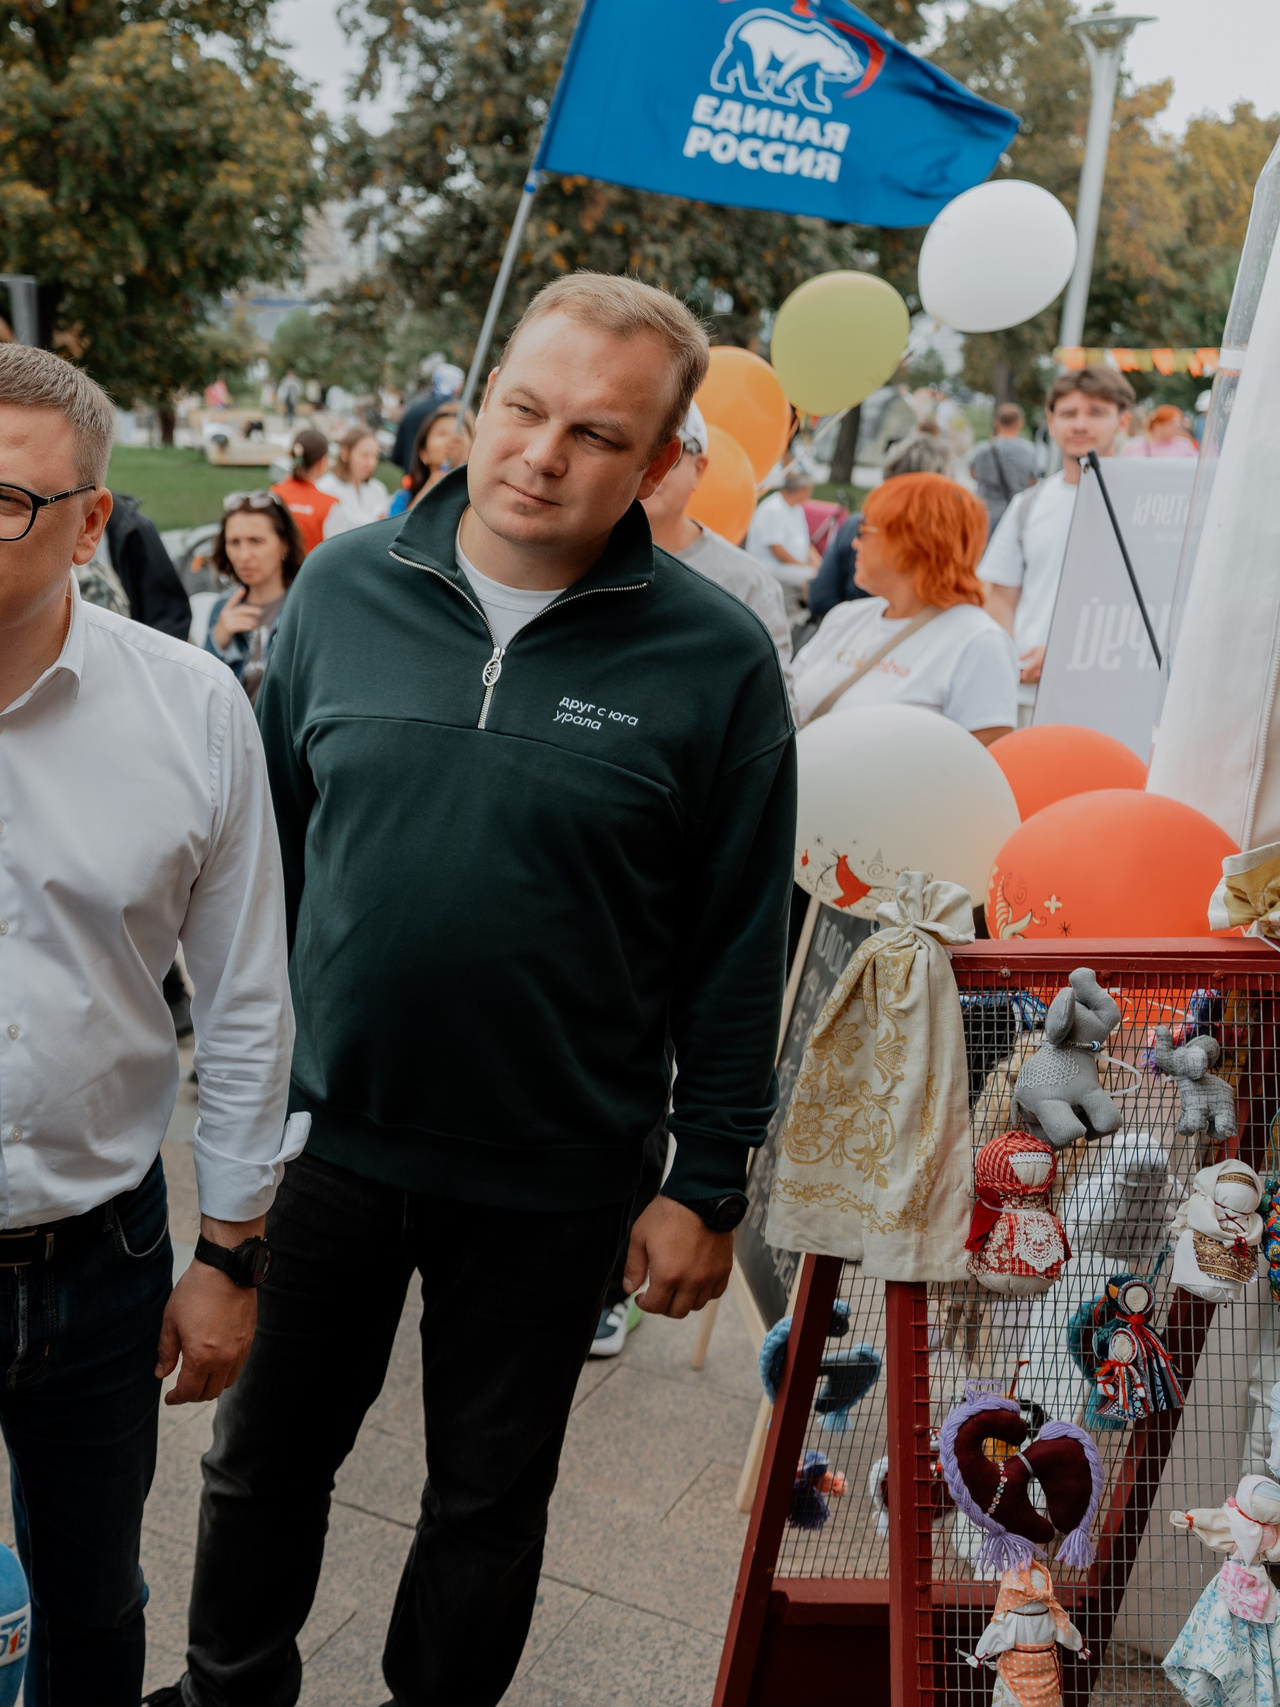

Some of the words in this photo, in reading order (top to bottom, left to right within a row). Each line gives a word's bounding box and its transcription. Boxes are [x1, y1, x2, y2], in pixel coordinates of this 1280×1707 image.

[692, 93, 851, 153] ЕДИНАЯ
[683, 125, 842, 183] РОССИЯ
[552, 710, 602, 730] урала
[558, 696, 596, 714] друг
[597, 707, 607, 717] с
[608, 710, 639, 727] юга
